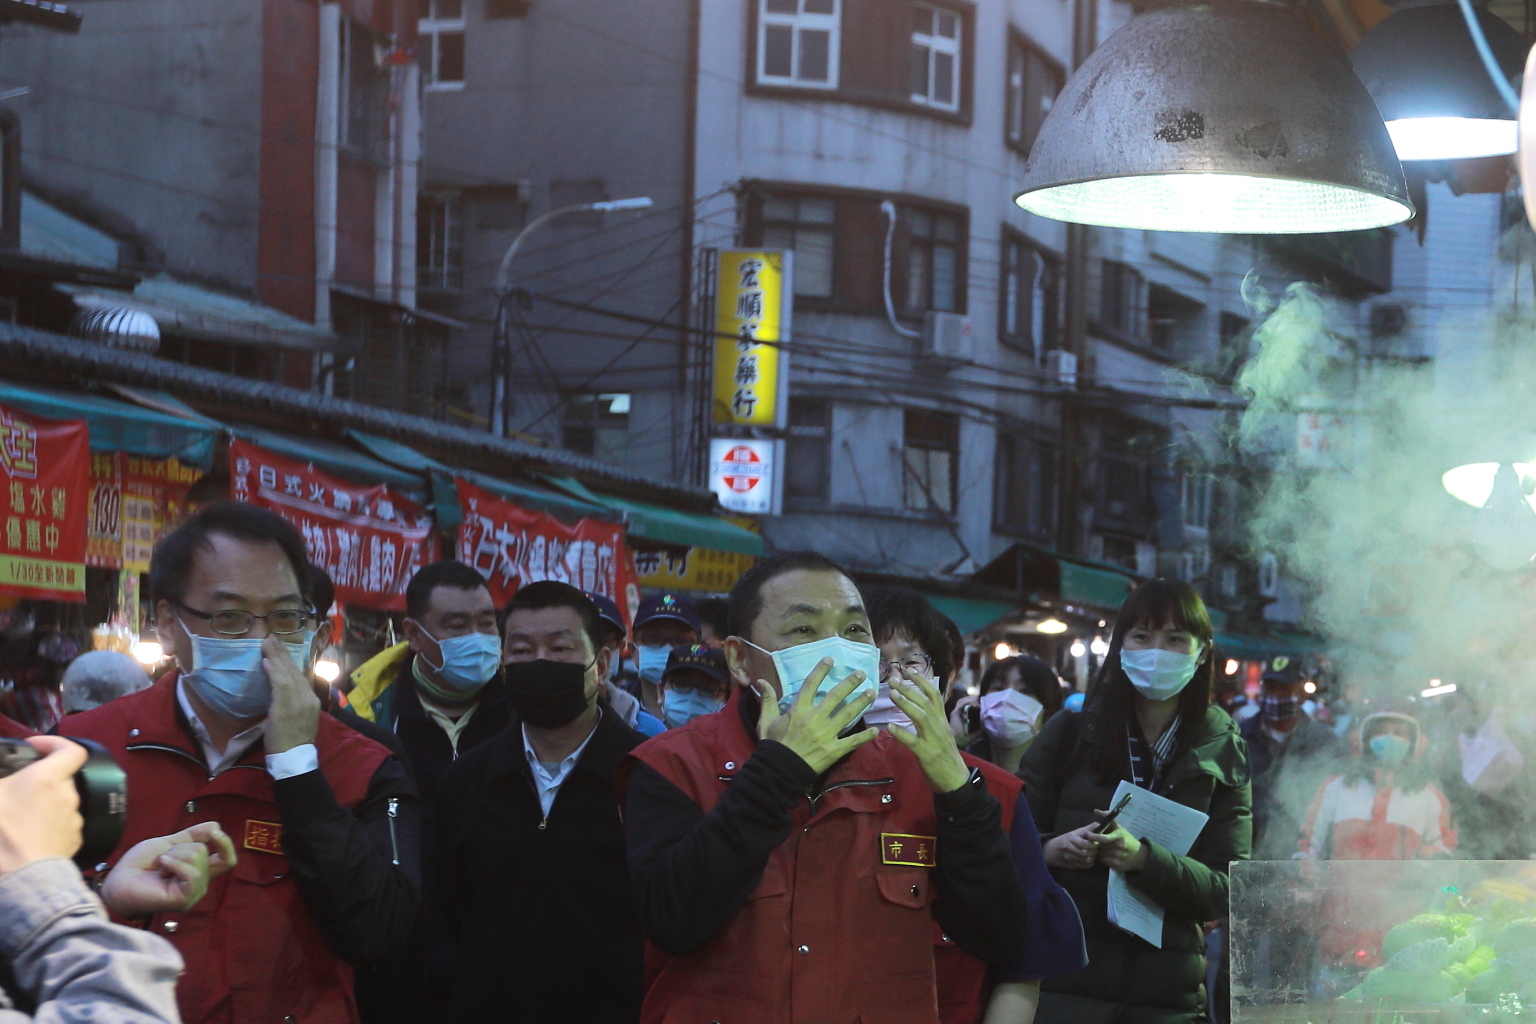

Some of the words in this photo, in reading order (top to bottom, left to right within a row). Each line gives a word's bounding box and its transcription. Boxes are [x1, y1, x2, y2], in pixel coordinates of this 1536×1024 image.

[92, 484, 121, 537] 130
[6, 515, 60, 556] 優惠中
[889, 841, 928, 860] 市長
